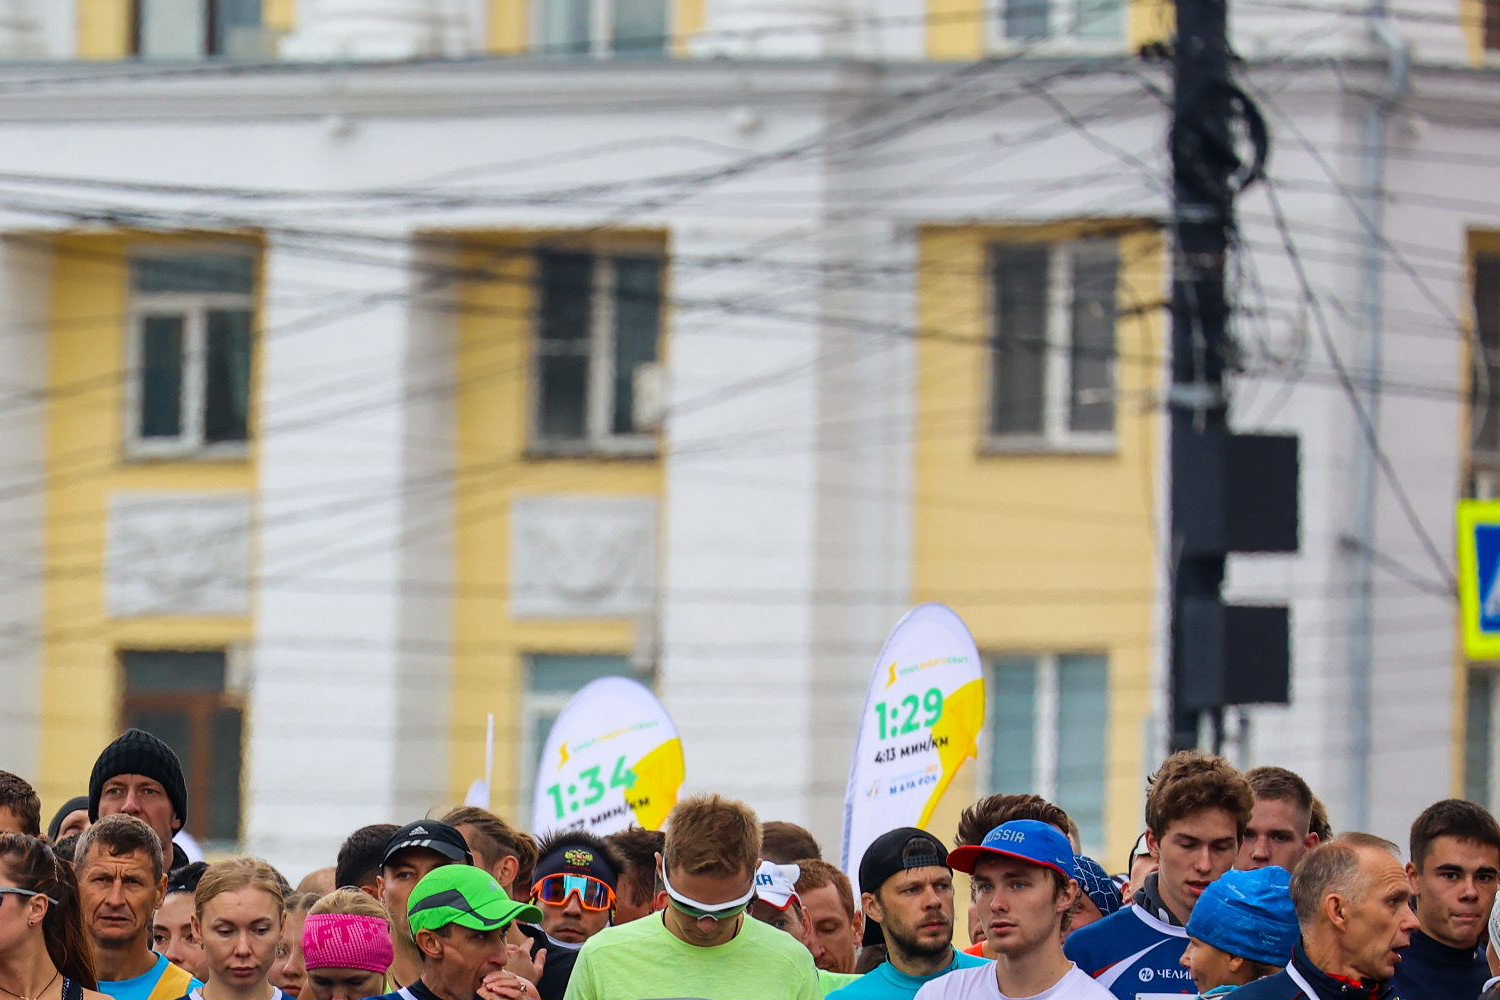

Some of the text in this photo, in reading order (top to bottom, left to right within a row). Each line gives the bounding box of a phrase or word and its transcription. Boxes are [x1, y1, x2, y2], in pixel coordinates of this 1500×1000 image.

[875, 687, 943, 740] 1:29
[874, 748, 896, 764] 4:13
[547, 754, 638, 819] 1:34
